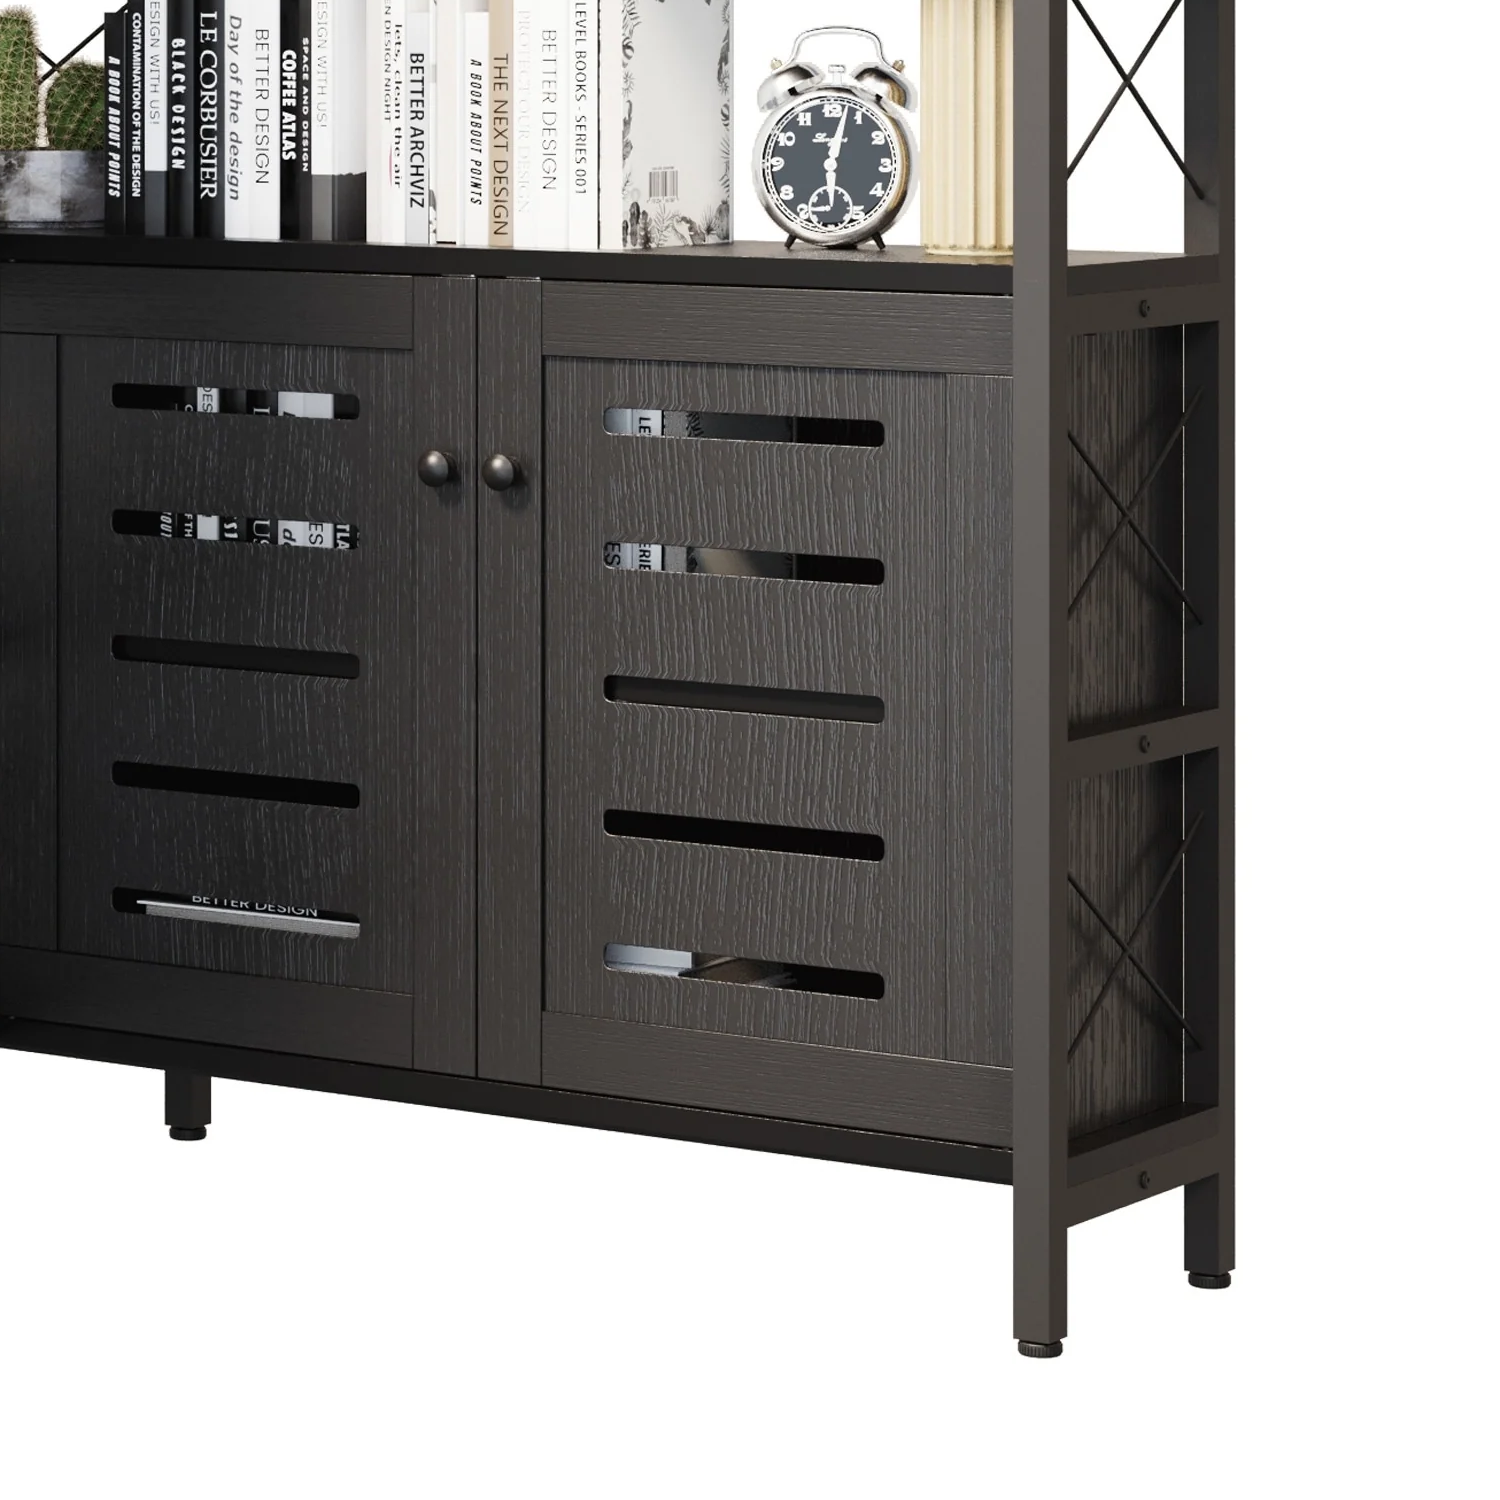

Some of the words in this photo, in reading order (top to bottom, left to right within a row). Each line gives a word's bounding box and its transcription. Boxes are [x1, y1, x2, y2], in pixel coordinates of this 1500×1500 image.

[200, 10, 218, 43] LE
[227, 15, 242, 56] Day
[574, 1, 588, 46] LEVEL
[108, 55, 121, 65] A
[131, 12, 142, 110] CONTAMINATION
[149, 54, 161, 93] WITH
[171, 38, 187, 95] BLACK
[229, 62, 243, 85] of
[255, 29, 270, 100] BETTER
[281, 49, 297, 107] COFFEE
[302, 37, 310, 81] SPACE
[470, 59, 482, 67] A
[493, 53, 509, 92] THE
[574, 50, 588, 103] BOOKS
[108, 69, 121, 104] BOOK
[229, 90, 243, 124] the
[409, 53, 425, 121] BETTER
[470, 72, 482, 107] BOOK
[108, 106, 121, 149] ABOUT
[131, 111, 142, 128] OF
[149, 99, 161, 125] US!
[199, 49, 218, 199] CORBUSIER
[493, 99, 509, 152] NEXT
[822, 103, 842, 118] 12
[853, 111, 863, 124] 1
[131, 128, 141, 152] THE
[170, 104, 186, 170] DESIGN
[255, 108, 270, 184] DESIGN
[281, 111, 297, 161] ATLAS
[301, 120, 309, 172] DESIGN
[470, 111, 483, 154] ABOUT
[574, 114, 588, 165] SERIES
[778, 131, 796, 147] 10
[871, 131, 885, 145] 2
[108, 151, 121, 198] POINTS
[131, 153, 141, 197] DESIGN
[226, 131, 243, 201] design
[409, 125, 425, 208] ARCHVIZ
[470, 158, 482, 206] POINTS
[574, 169, 588, 195] 001
[770, 157, 785, 171] 9
[878, 158, 892, 173] 3
[493, 159, 509, 236] DESIGN
[780, 185, 794, 200] 8
[869, 182, 885, 197] 4
